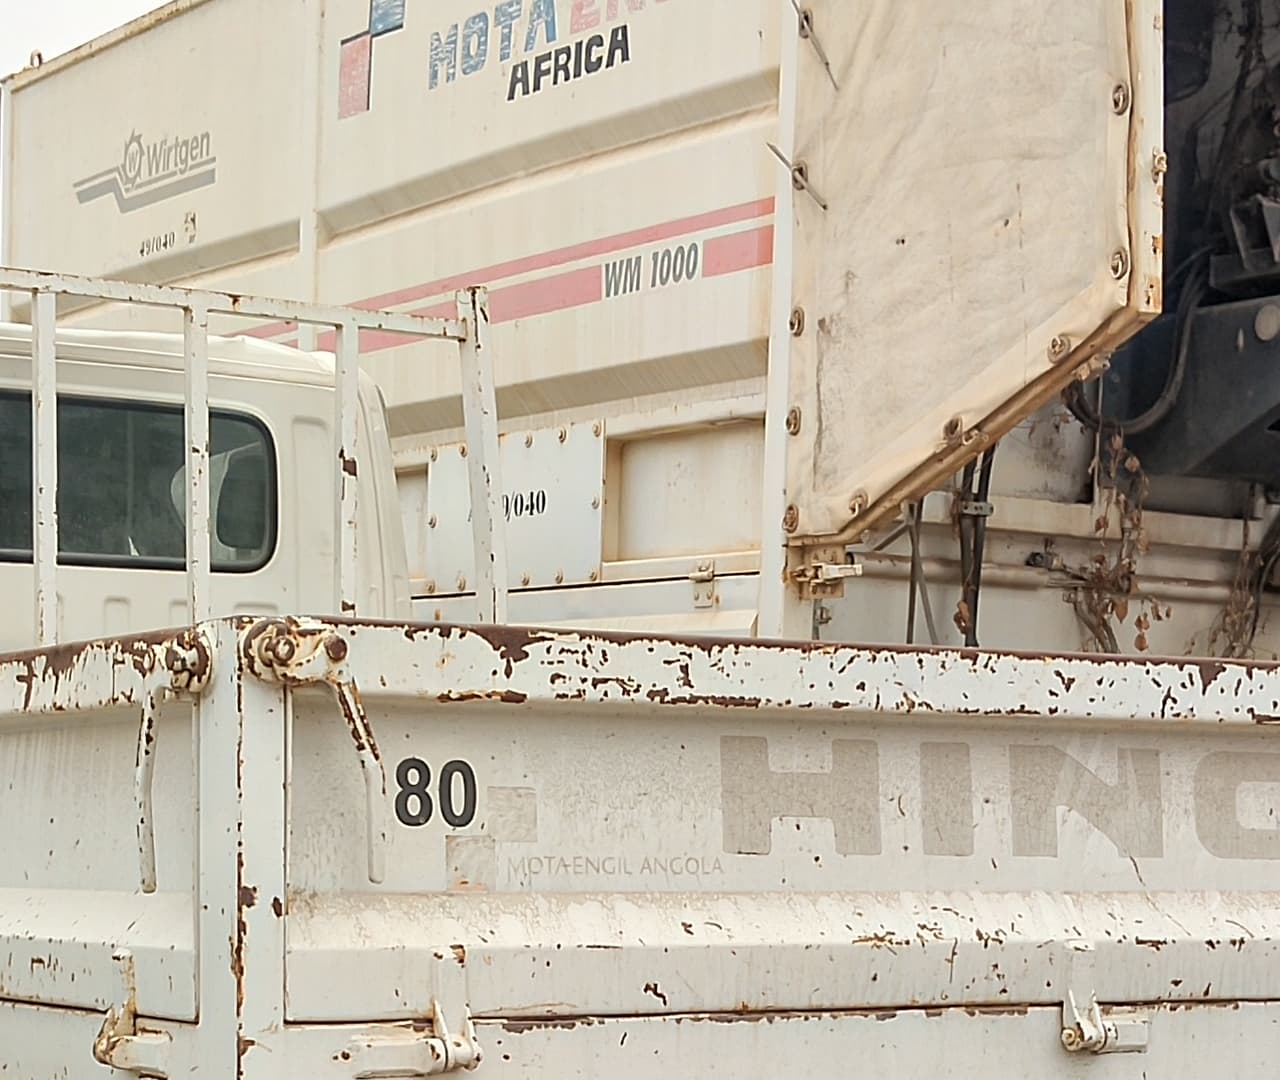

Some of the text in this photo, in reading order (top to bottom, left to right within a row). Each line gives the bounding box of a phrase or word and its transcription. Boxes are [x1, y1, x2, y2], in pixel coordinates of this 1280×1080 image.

[428, 0, 557, 90] MOTA
[507, 24, 630, 101] AFRICA
[147, 131, 210, 175] Wirtgen
[605, 242, 699, 298] WM 1000
[394, 757, 478, 828] 80
[639, 855, 725, 877] ANGOLA
